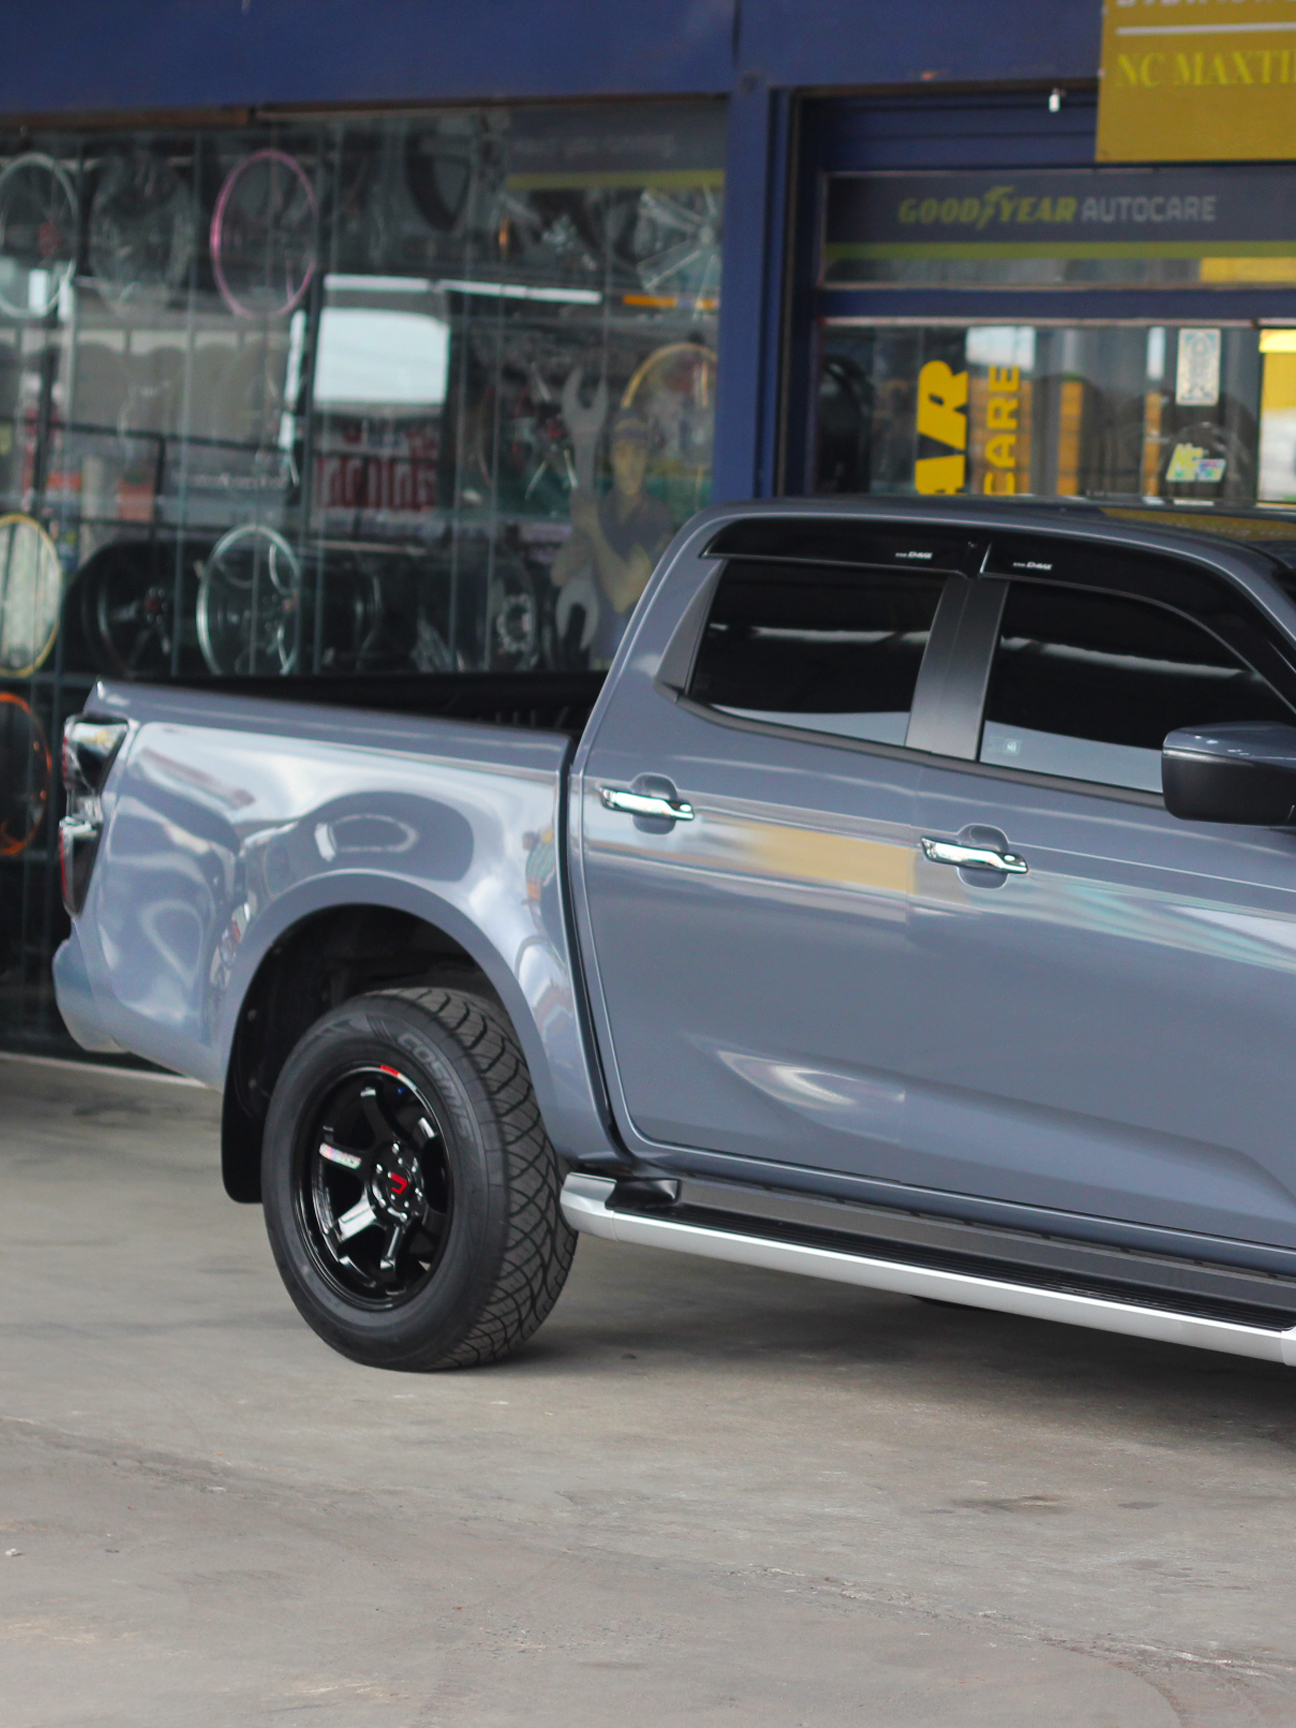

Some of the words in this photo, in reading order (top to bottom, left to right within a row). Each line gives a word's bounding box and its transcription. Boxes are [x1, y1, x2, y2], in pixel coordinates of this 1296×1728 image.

[1116, 53, 1161, 88] NC
[900, 186, 1077, 230] GOODYEAR
[1082, 196, 1216, 223] AUTOCARE
